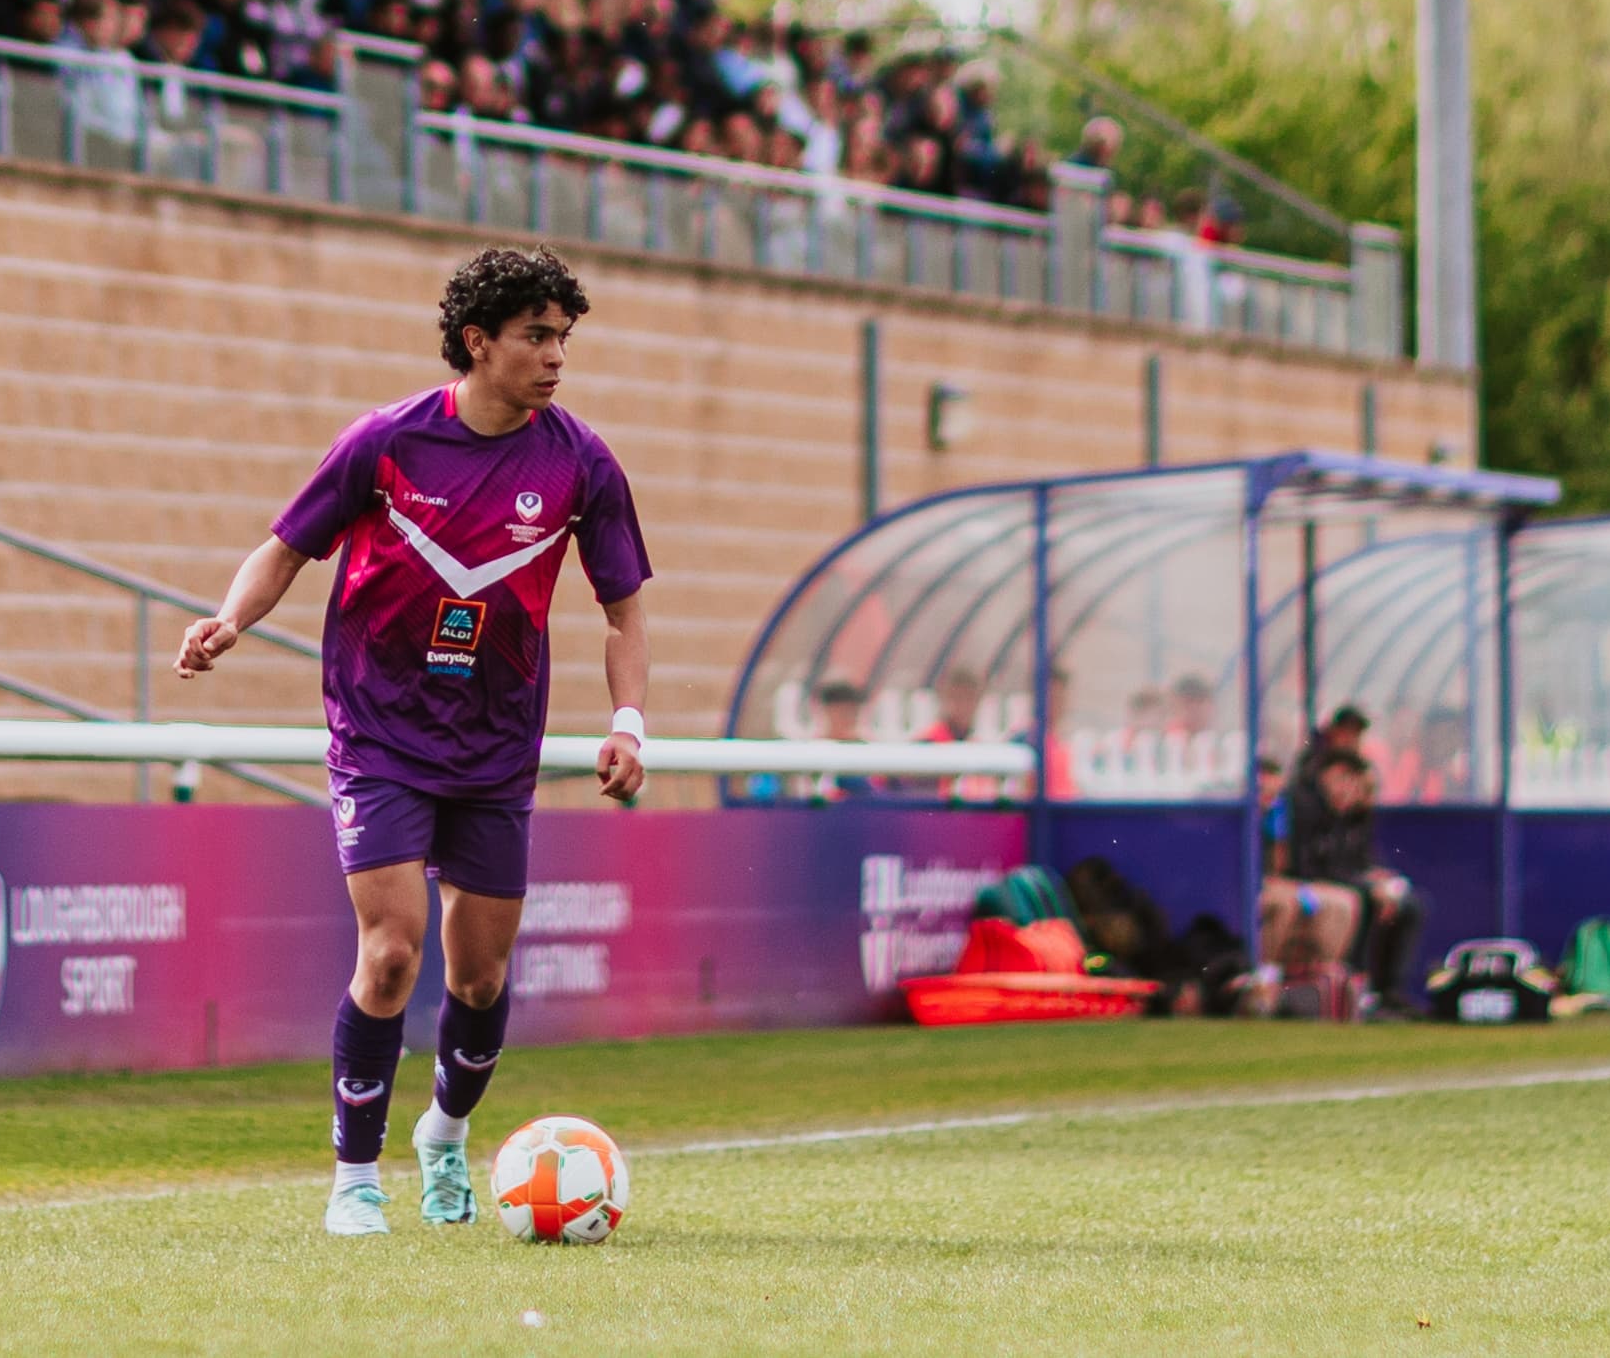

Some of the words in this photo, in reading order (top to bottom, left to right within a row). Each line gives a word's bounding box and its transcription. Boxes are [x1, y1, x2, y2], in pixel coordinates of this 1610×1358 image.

[411, 492, 448, 506] KUKRI
[440, 627, 472, 640] ALDI
[426, 650, 476, 666] Everyday
[60, 954, 138, 1016] SPORT
